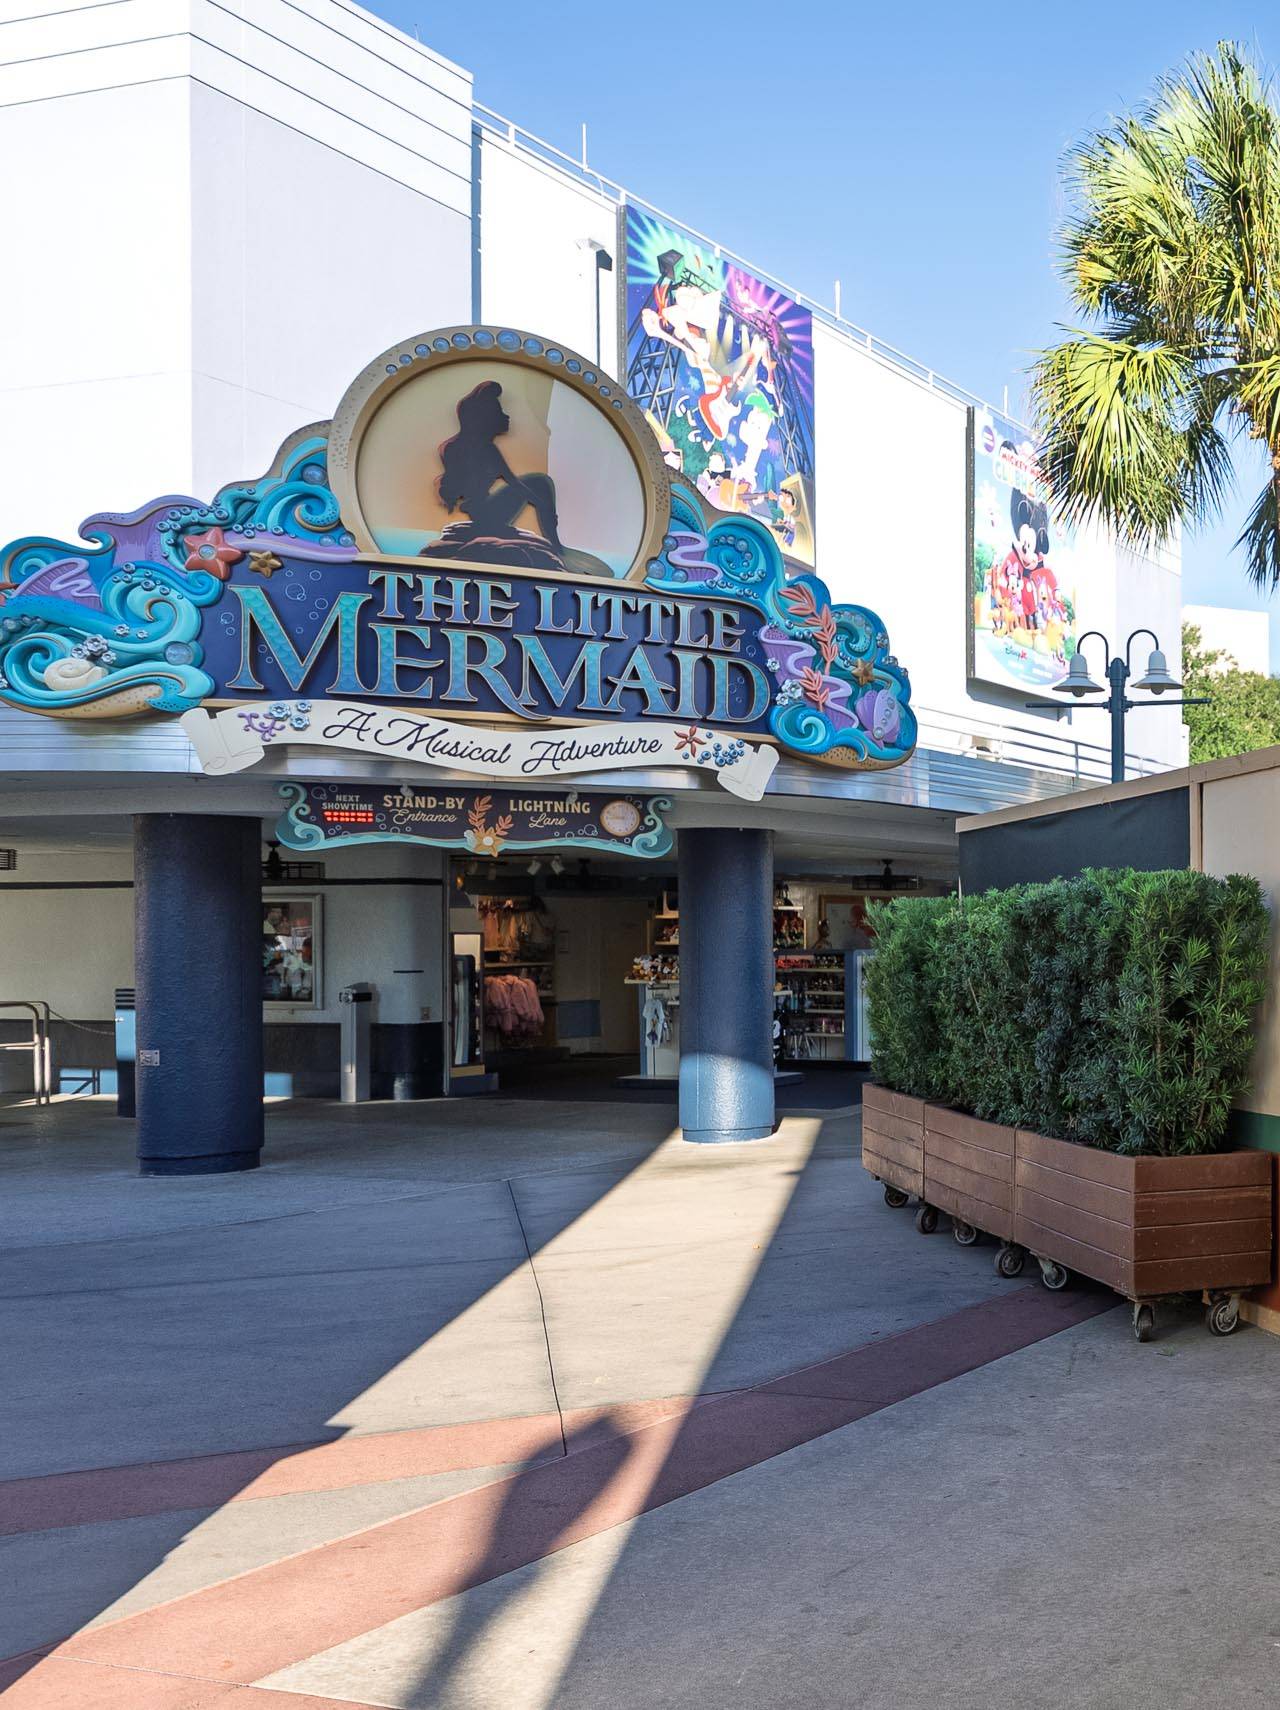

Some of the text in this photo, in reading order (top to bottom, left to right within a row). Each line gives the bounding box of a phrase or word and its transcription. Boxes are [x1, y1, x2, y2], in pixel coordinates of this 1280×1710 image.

[368, 569, 747, 653] THE LITTLE
[225, 583, 771, 723] MERMAID
[322, 707, 663, 773] A Musical Adventure
[335, 794, 361, 802] NEXT
[383, 794, 466, 810] STAND-BY
[321, 802, 374, 811] SHOWTIME
[509, 799, 591, 814] LIGHTNING
[389, 809, 457, 825] Entrance
[528, 812, 567, 828] Lane
